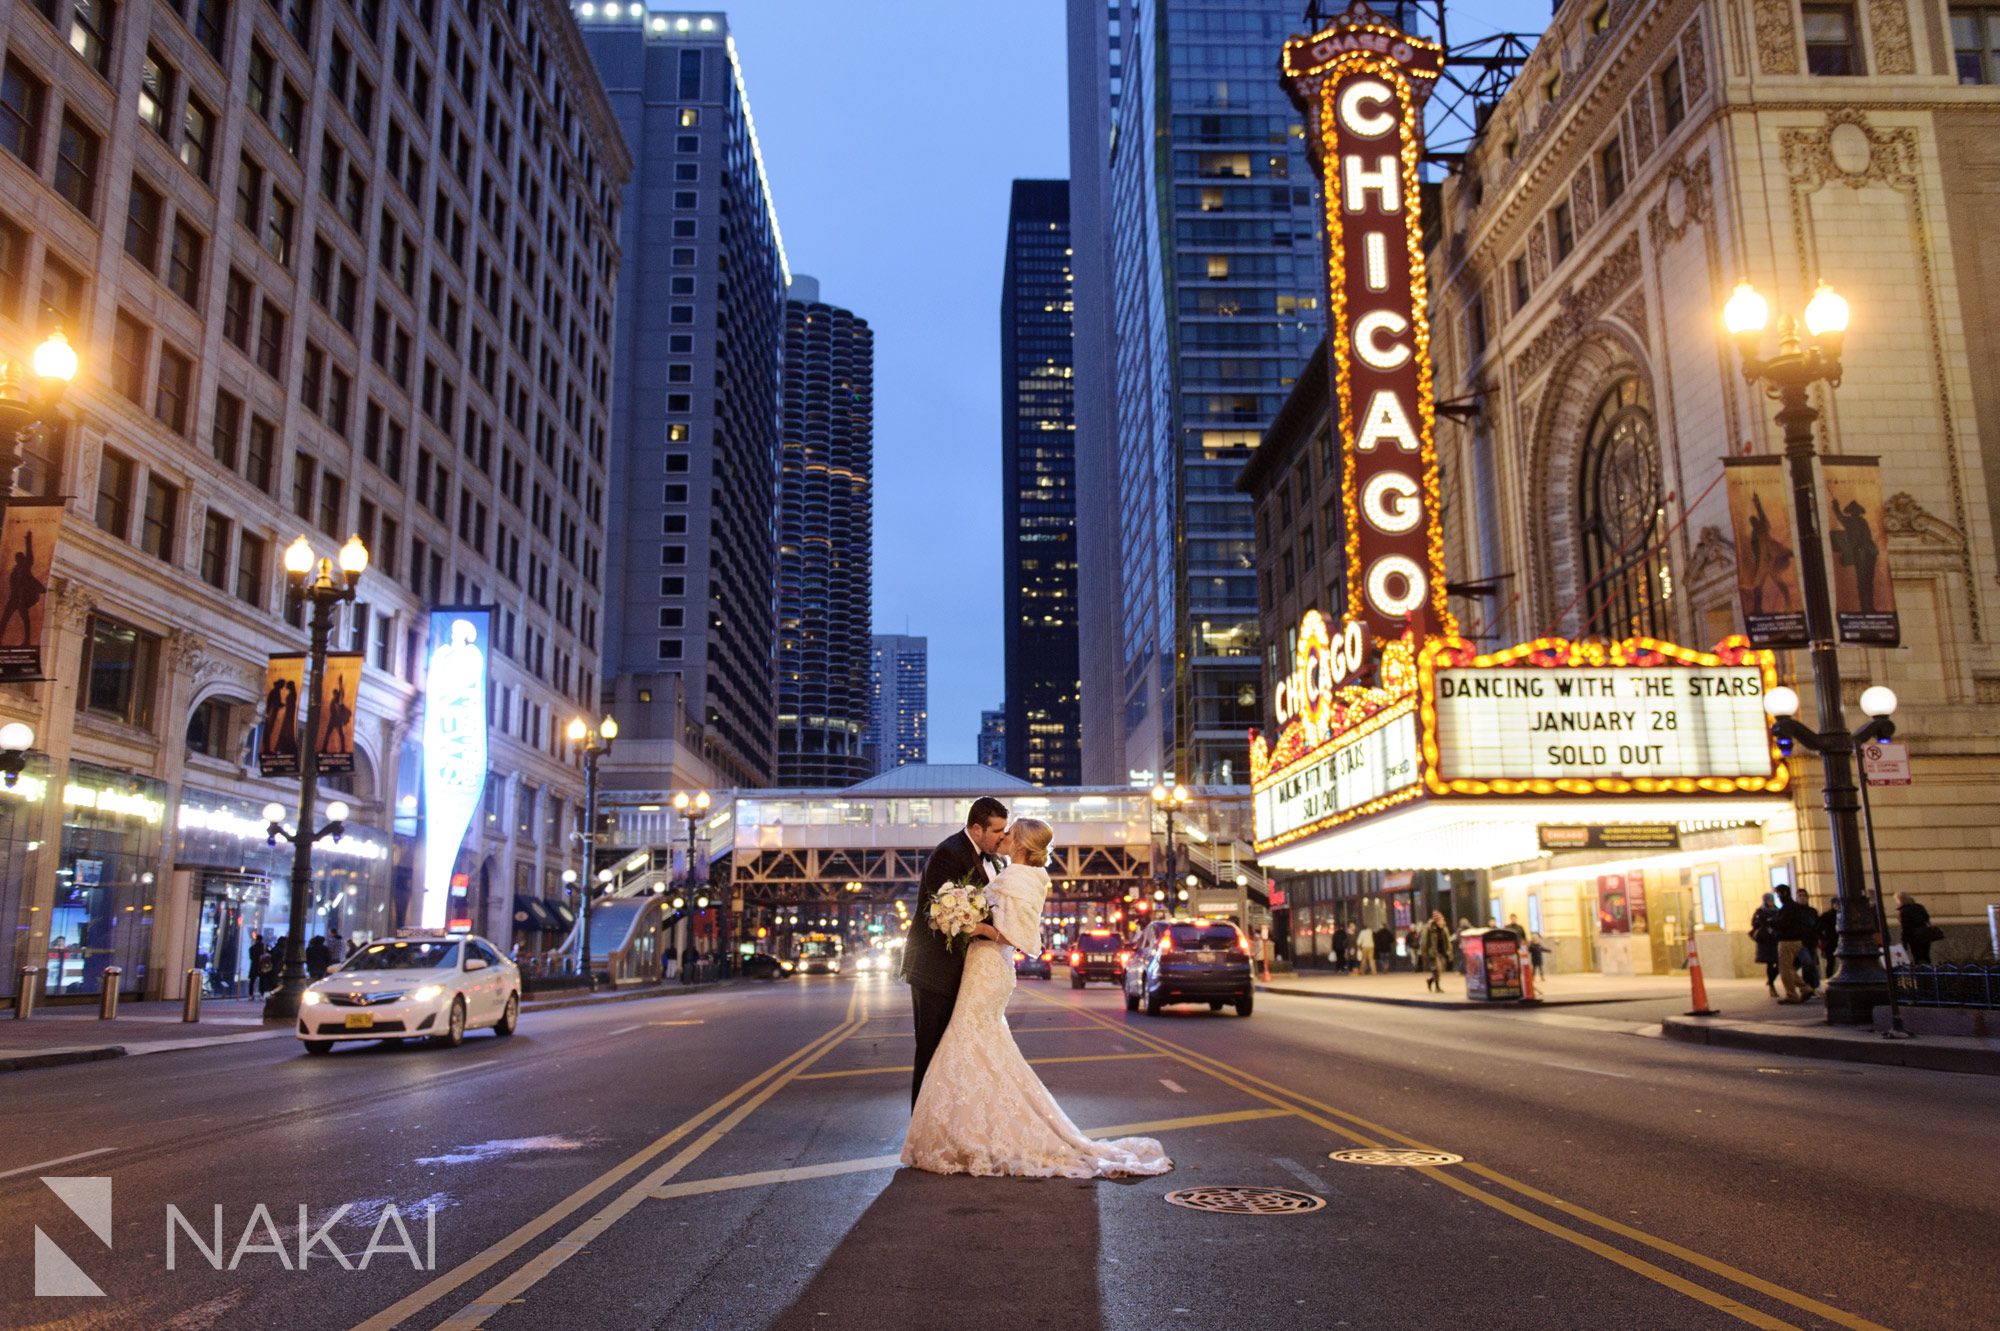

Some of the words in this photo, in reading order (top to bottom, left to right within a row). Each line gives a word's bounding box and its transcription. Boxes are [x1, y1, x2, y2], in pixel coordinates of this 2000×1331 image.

[1312, 33, 1390, 61] CHASE
[1339, 80, 1427, 617] CHICAGO
[1275, 620, 1362, 724] CHICAGO
[1440, 677, 1543, 698] DANCING
[1555, 677, 1614, 697] WITH
[1632, 677, 1674, 696] THE
[1688, 676, 1760, 696] STARS
[1531, 711, 1636, 731] JANUARY
[1651, 711, 1678, 730] 28
[1547, 745, 1606, 765] SOLD
[1619, 745, 1663, 765] OUT
